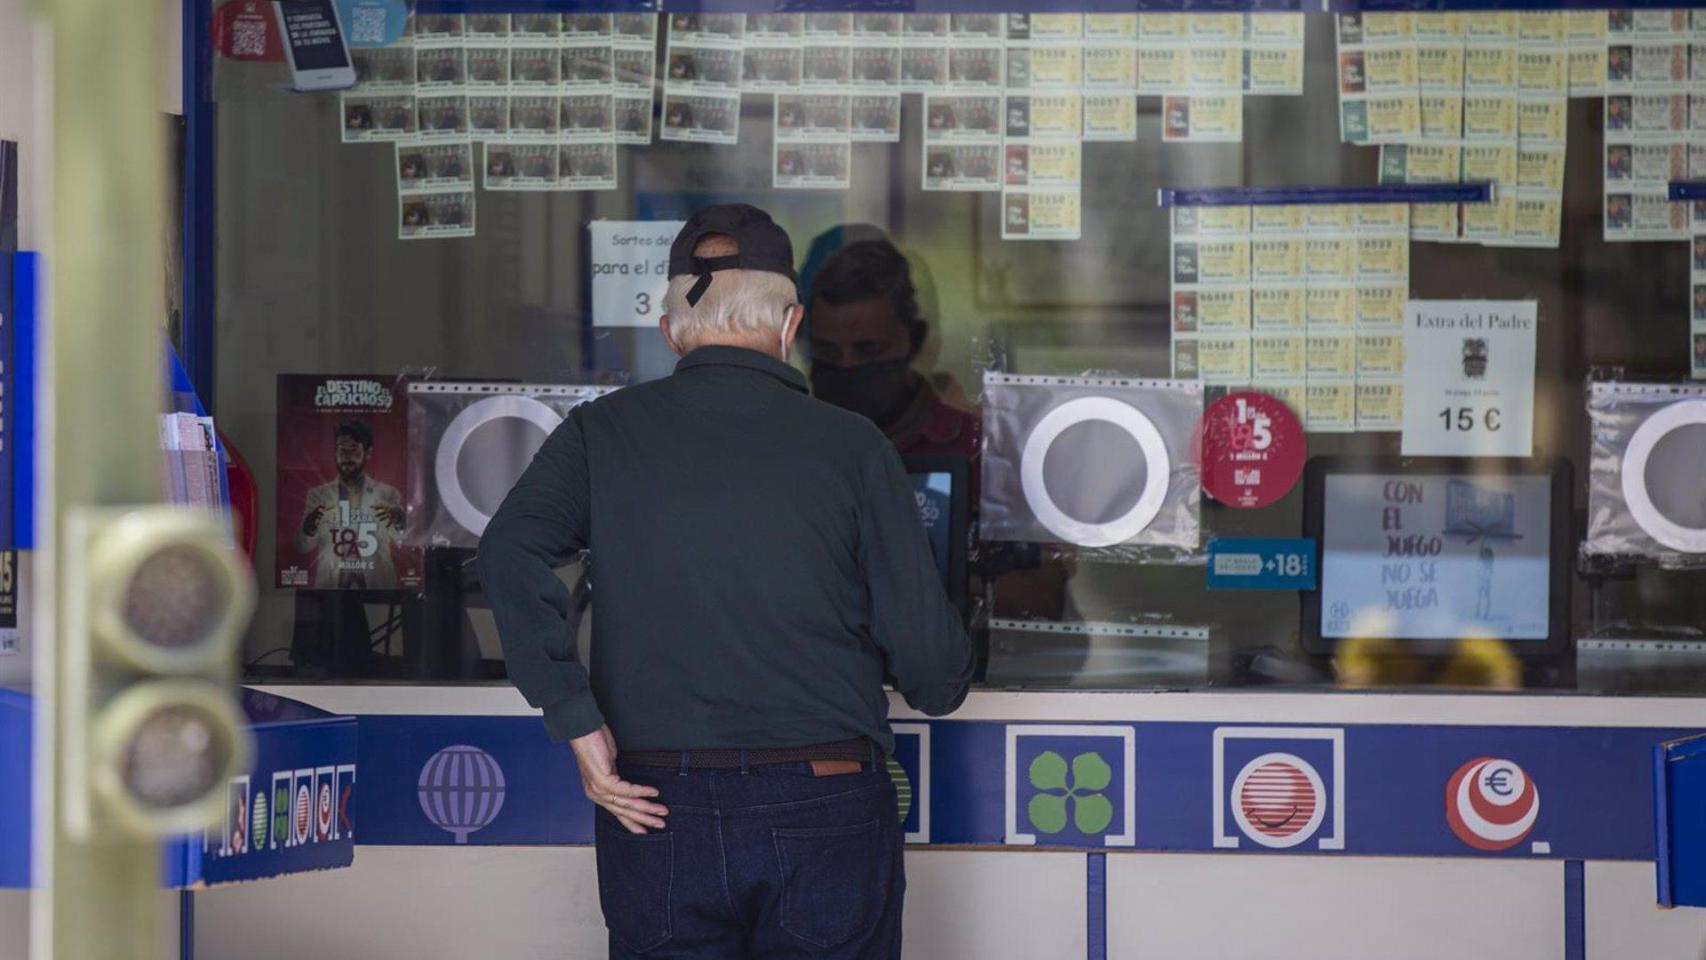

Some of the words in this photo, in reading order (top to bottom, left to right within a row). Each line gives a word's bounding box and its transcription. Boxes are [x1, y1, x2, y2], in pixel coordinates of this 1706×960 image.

[612, 234, 653, 246] Sorteo
[592, 263, 629, 278] para
[634, 259, 648, 274] el
[1417, 313, 1454, 329] Extra
[1459, 313, 1482, 329] del
[1489, 314, 1532, 330] Padre
[326, 379, 381, 395] DESTINO
[315, 393, 393, 408] CAPRICHOSO
[1235, 398, 1247, 424] 1
[1439, 408, 1474, 431] 15
[1484, 408, 1501, 431] €
[1252, 418, 1272, 450] 5
[1384, 480, 1423, 504] CON
[339, 500, 350, 527] 1
[1383, 507, 1402, 531] EL
[358, 522, 378, 557] 5
[1384, 535, 1442, 558] JUEGO
[1265, 553, 1301, 576] +18
[1381, 563, 1411, 585] NO
[1419, 560, 1437, 583] SE
[1384, 588, 1440, 612] JUEGA
